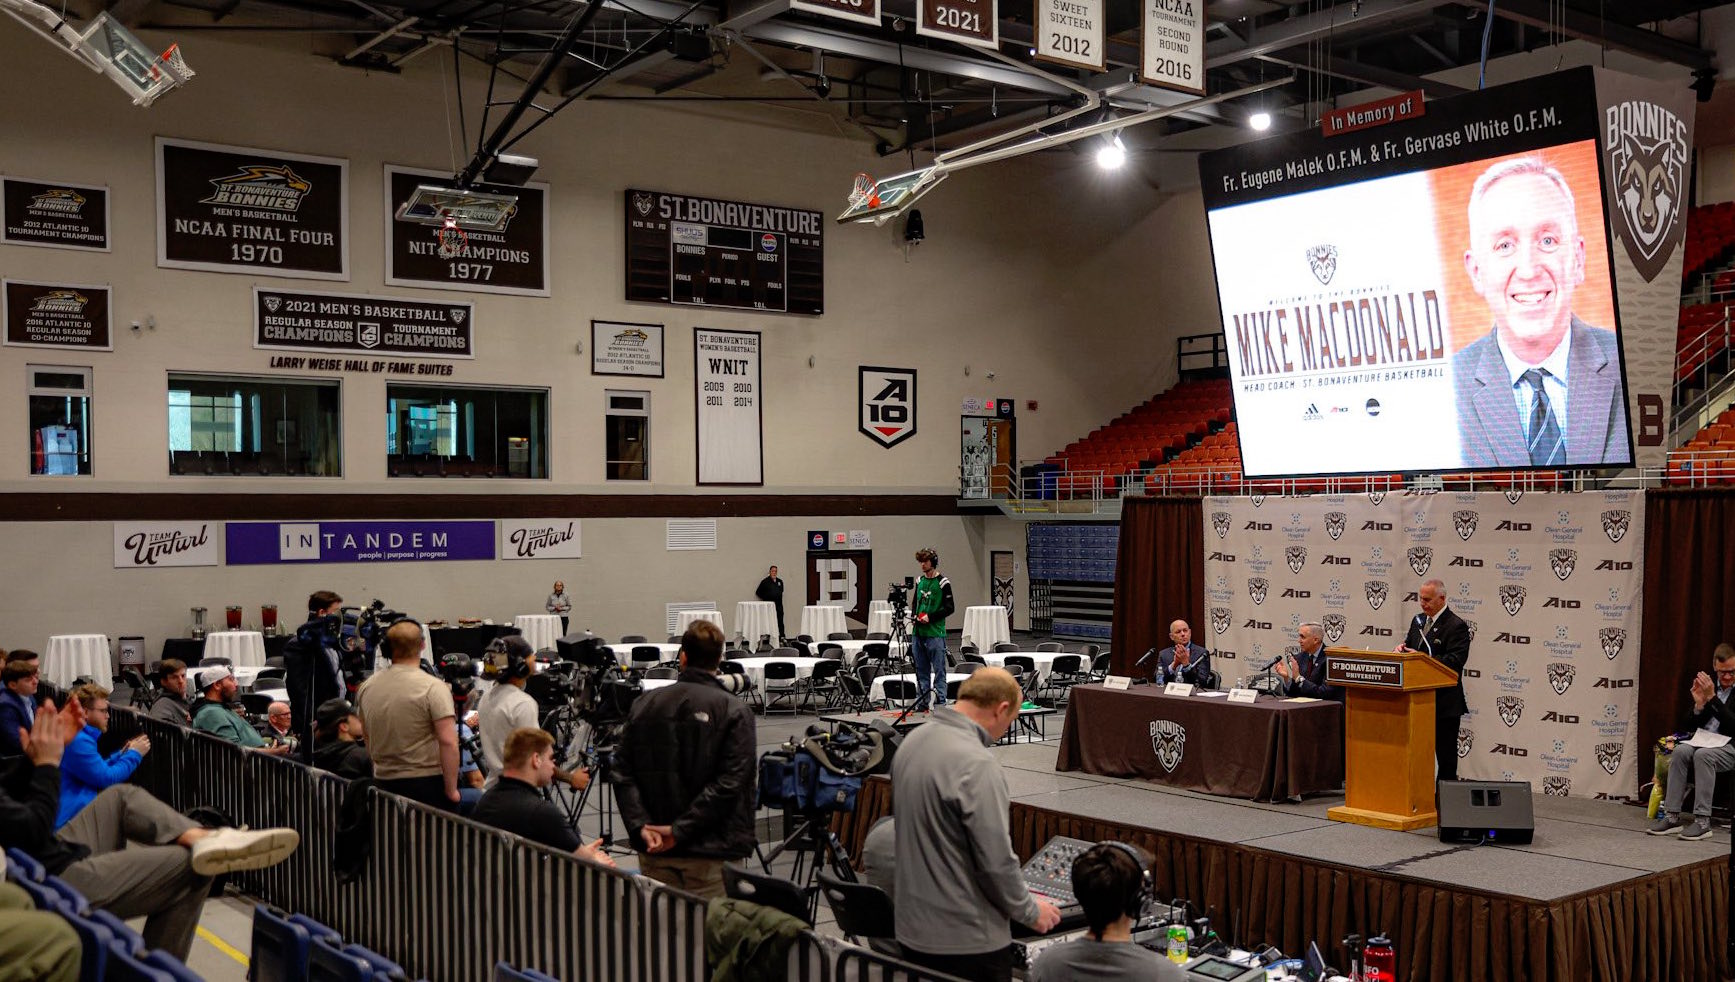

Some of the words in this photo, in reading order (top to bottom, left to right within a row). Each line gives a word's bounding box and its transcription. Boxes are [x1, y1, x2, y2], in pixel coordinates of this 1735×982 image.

[1054, 0, 1088, 16] SWEET
[1156, 0, 1194, 16] NCAA
[936, 6, 980, 32] 2021
[1050, 12, 1092, 30] SIXTEEN
[1152, 11, 1196, 28] TOURNAMENT
[1158, 26, 1190, 42] SECOND
[1052, 33, 1090, 56] 2012
[1160, 39, 1189, 54] ROUND
[1156, 58, 1191, 80] 2016
[1331, 116, 1342, 130] In
[1347, 105, 1394, 126] Memory
[1400, 98, 1411, 114] of
[1606, 100, 1687, 164] BONNIES
[1223, 175, 1238, 192] Fr.
[1241, 168, 1283, 190] Eugene
[1286, 155, 1324, 180] Malek
[1326, 148, 1367, 172] O.F.M.
[1370, 144, 1380, 162] &
[1384, 141, 1401, 160] Fr.
[1405, 130, 1461, 155] Gervase
[1464, 120, 1509, 143] White
[1514, 106, 1562, 133] O.F.M.
[215, 192, 298, 210] BONNIES
[213, 207, 240, 217] MEN'S
[242, 210, 298, 222] BASKETBALL
[8, 227, 60, 237] TOURNAMENT
[62, 232, 104, 241] CHAMPIONS
[42, 222, 79, 231] ATLANTIC
[175, 219, 227, 237] NCAA
[232, 225, 285, 242] FINAL
[290, 230, 334, 246] FOUR
[232, 244, 283, 264] 1970
[409, 241, 436, 255] NIT
[677, 245, 705, 255] BONNIES
[1306, 244, 1338, 261] BONNIES
[757, 253, 778, 262] GUEST
[450, 263, 493, 281] 1977
[286, 300, 316, 313] 2021
[320, 303, 360, 315] MEN'S
[364, 306, 446, 322] BASKETBALL
[45, 320, 82, 328] ATLANTIC
[265, 316, 312, 328] REGULAR
[314, 319, 353, 330] SEASON
[393, 324, 457, 335] TOURNAMENT
[32, 334, 87, 343] CO-CHAMPIONS
[264, 326, 354, 343] CHAMPIONS
[384, 333, 466, 348] CHAMPIONS
[710, 336, 756, 345] BONAVENTURE
[1233, 309, 1293, 376] MIKE
[1295, 290, 1444, 371] MACDONALD
[270, 357, 306, 369] LARRY
[308, 358, 342, 370] WEISE
[344, 360, 369, 372] HALL
[372, 362, 385, 373] OF
[387, 362, 414, 374] FAME
[417, 364, 453, 376] SUITES
[709, 358, 748, 375] WNIT
[704, 382, 724, 391] 2009
[734, 383, 752, 392] 2010
[1244, 383, 1265, 392] HEAD
[1268, 381, 1295, 391] COACH
[1303, 379, 1315, 388] ST.
[1318, 373, 1381, 387] BONAVENTURE
[1385, 368, 1444, 381] BASKETBALL
[872, 378, 907, 402] A
[707, 396, 723, 406] 2011
[734, 397, 752, 406] 2014
[865, 404, 908, 422] 10
[1638, 394, 1664, 446] B
[1212, 512, 1232, 522] BONNIES
[1324, 512, 1346, 522] BONNIES
[1453, 510, 1479, 522] BONNIES
[1244, 522, 1272, 531] A10
[1495, 520, 1531, 531] A10
[150, 531, 172, 541] TEAM
[510, 522, 574, 557] Unfurl
[124, 524, 208, 565] Unfurl
[1285, 546, 1307, 556] BONNIES
[1321, 555, 1351, 565] A10
[1549, 549, 1577, 561] BONNIES
[1594, 560, 1632, 570] A10
[1365, 581, 1389, 592] BONNIES
[1542, 597, 1580, 609] A10
[1211, 607, 1232, 617] BONNIES
[1360, 626, 1392, 636] A10
[1599, 627, 1627, 640] BONNIES
[1592, 677, 1633, 688] A10
[1497, 696, 1524, 709] BONNIES
[1150, 720, 1185, 742] BONNIES
[1489, 743, 1528, 757] A10
